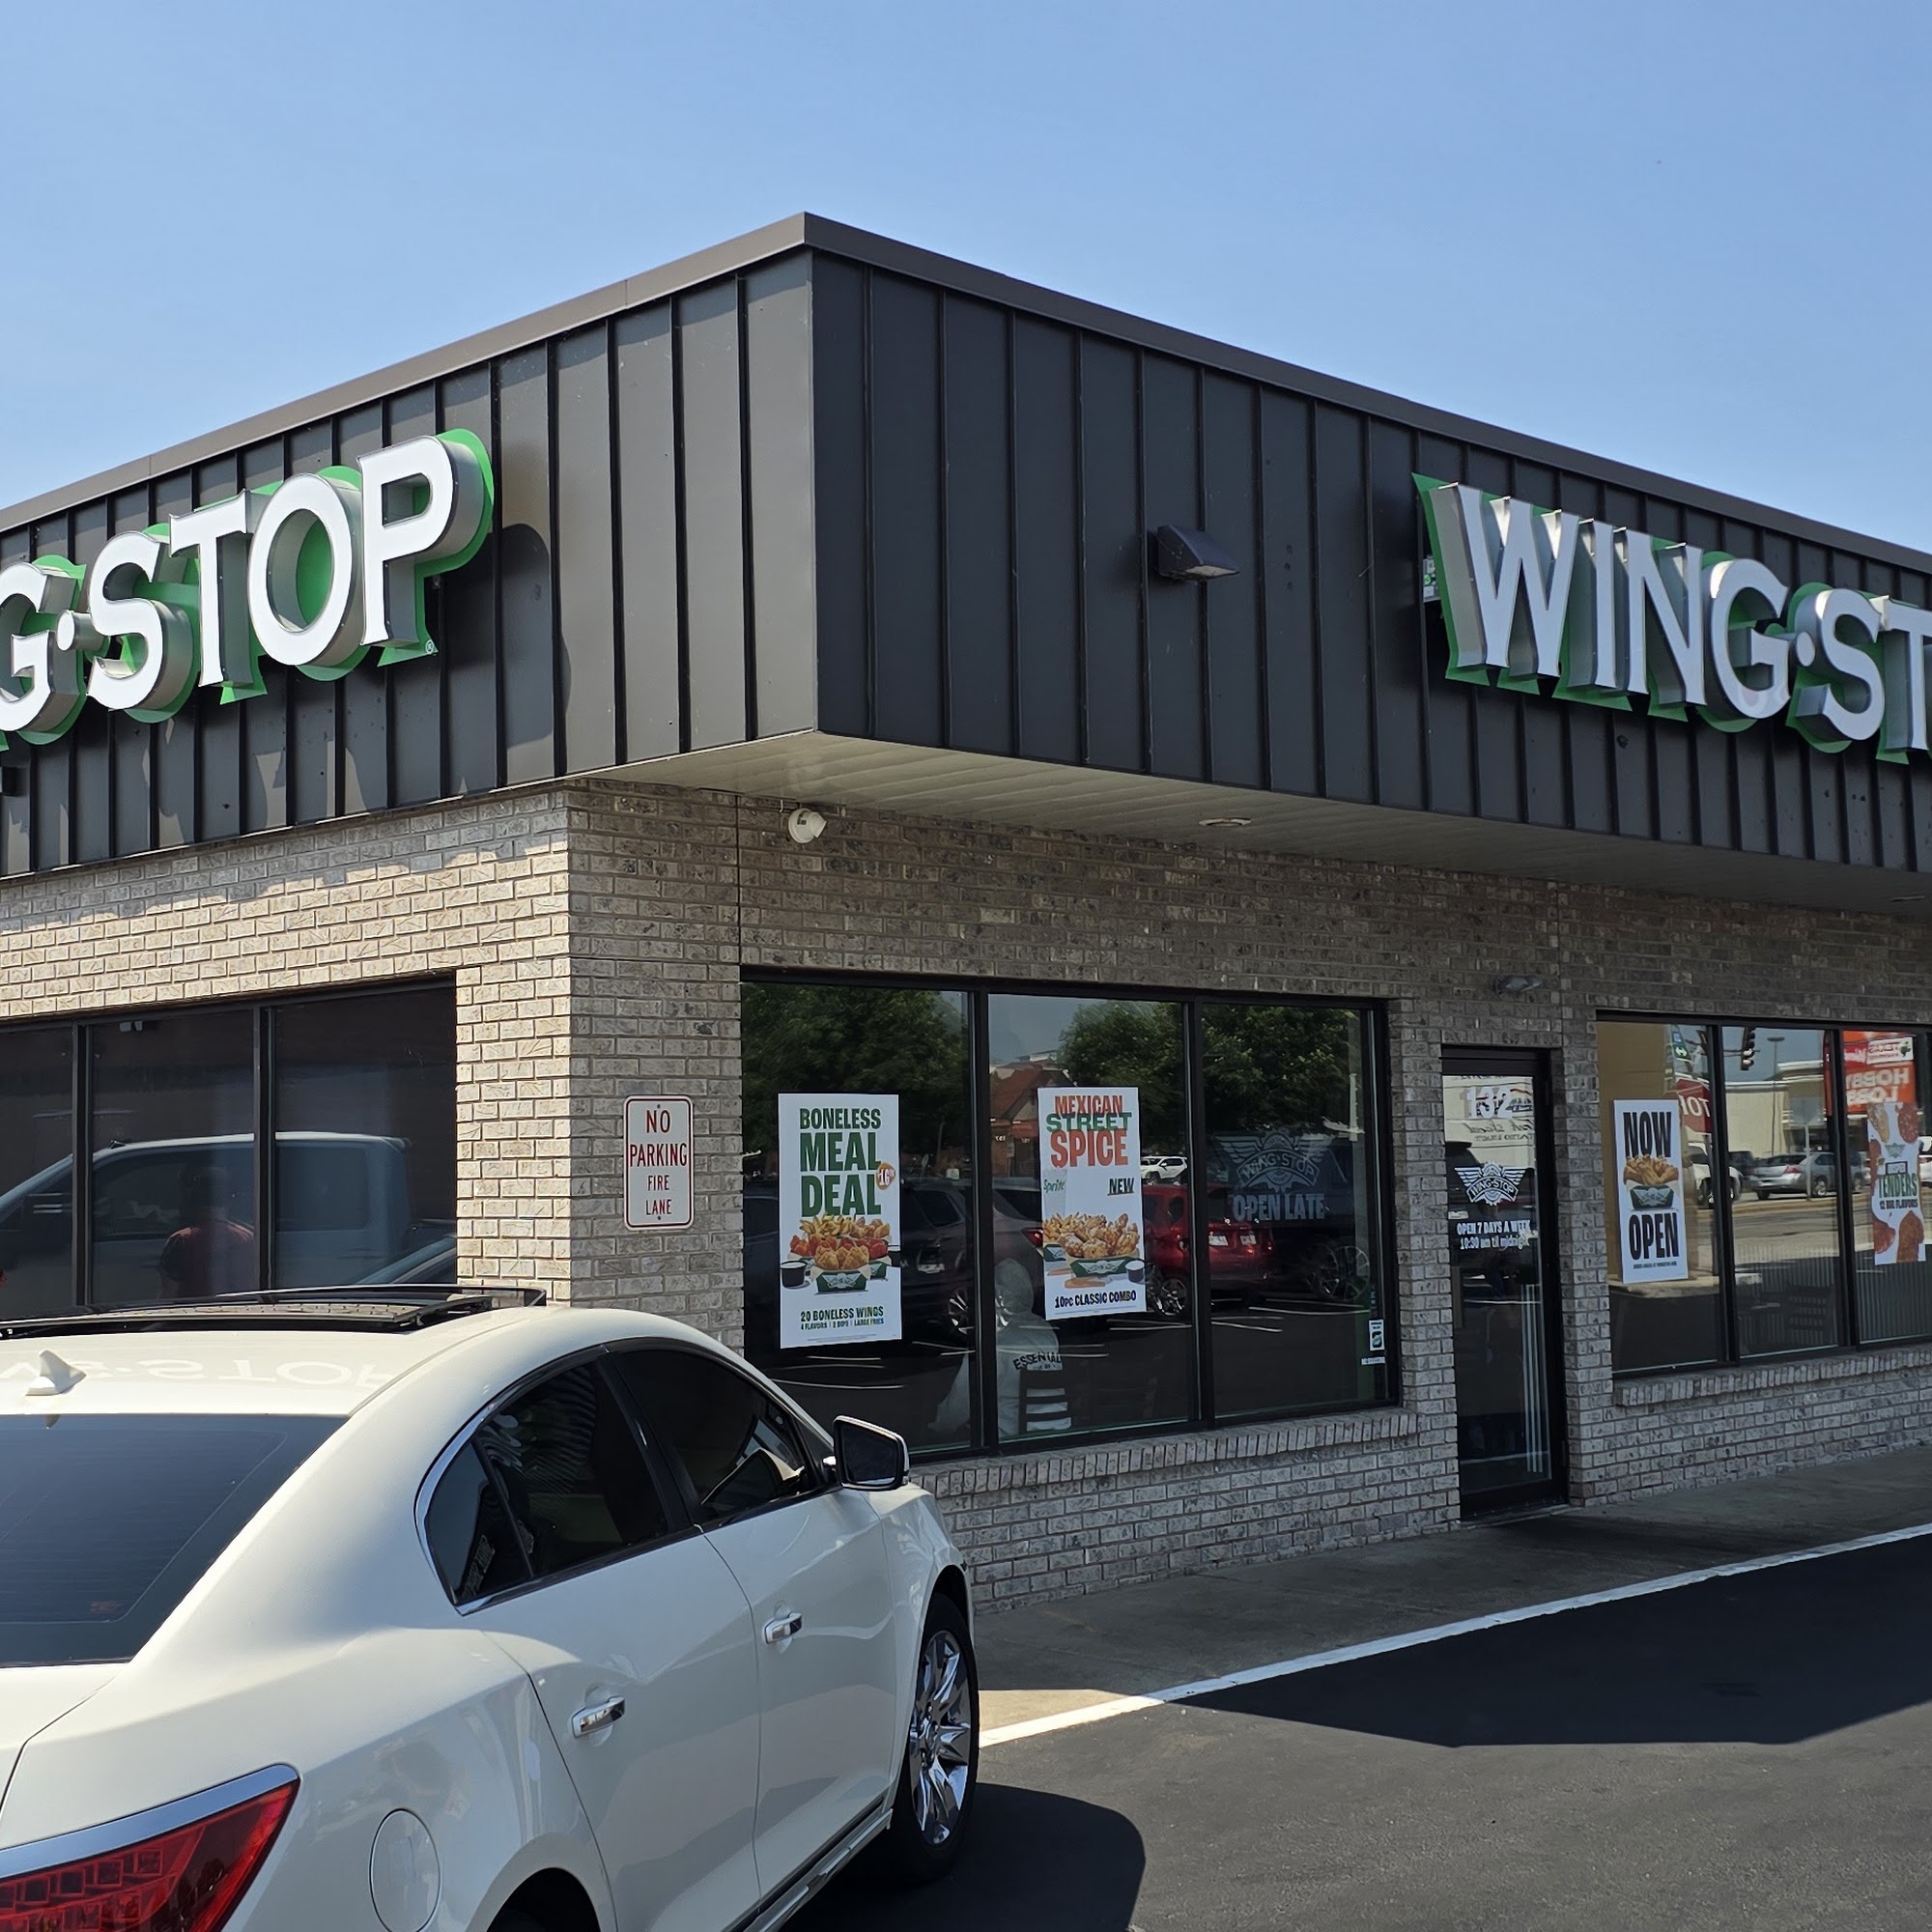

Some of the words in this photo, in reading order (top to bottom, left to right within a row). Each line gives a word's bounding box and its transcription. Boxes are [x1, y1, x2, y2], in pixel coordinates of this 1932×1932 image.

[1055, 1094, 1122, 1114] MEXICAN
[1466, 1087, 1513, 1119] 132
[646, 1110, 670, 1133] NO
[800, 1108, 881, 1129] BONELESS
[1046, 1112, 1132, 1132] STREET
[1623, 1111, 1671, 1157] NOW
[630, 1143, 687, 1167] PARKING
[800, 1132, 881, 1172] MEAL
[1050, 1127, 1128, 1168] SPICE
[647, 1175, 669, 1191] FIRE
[1043, 1179, 1065, 1193] Sprite
[1108, 1178, 1134, 1194] NEW
[1879, 1173, 1918, 1198] TENDERS
[801, 1174, 881, 1217] DEAL
[646, 1199, 671, 1215] LANE
[1233, 1194, 1281, 1221] OPEN
[1285, 1193, 1324, 1219] LATE
[1457, 1223, 1476, 1235] OPEN
[1477, 1222, 1482, 1234] 7
[1484, 1221, 1502, 1234] DAYS
[1504, 1221, 1510, 1233] A
[1510, 1219, 1530, 1233] WEEK
[1629, 1212, 1679, 1260] OPEN
[1074, 1293, 1107, 1306] CLASSIC
[1109, 1290, 1136, 1303] COMBO
[801, 1311, 810, 1321] 20
[812, 1308, 854, 1321] BONELESS
[856, 1306, 884, 1318] WINGS
